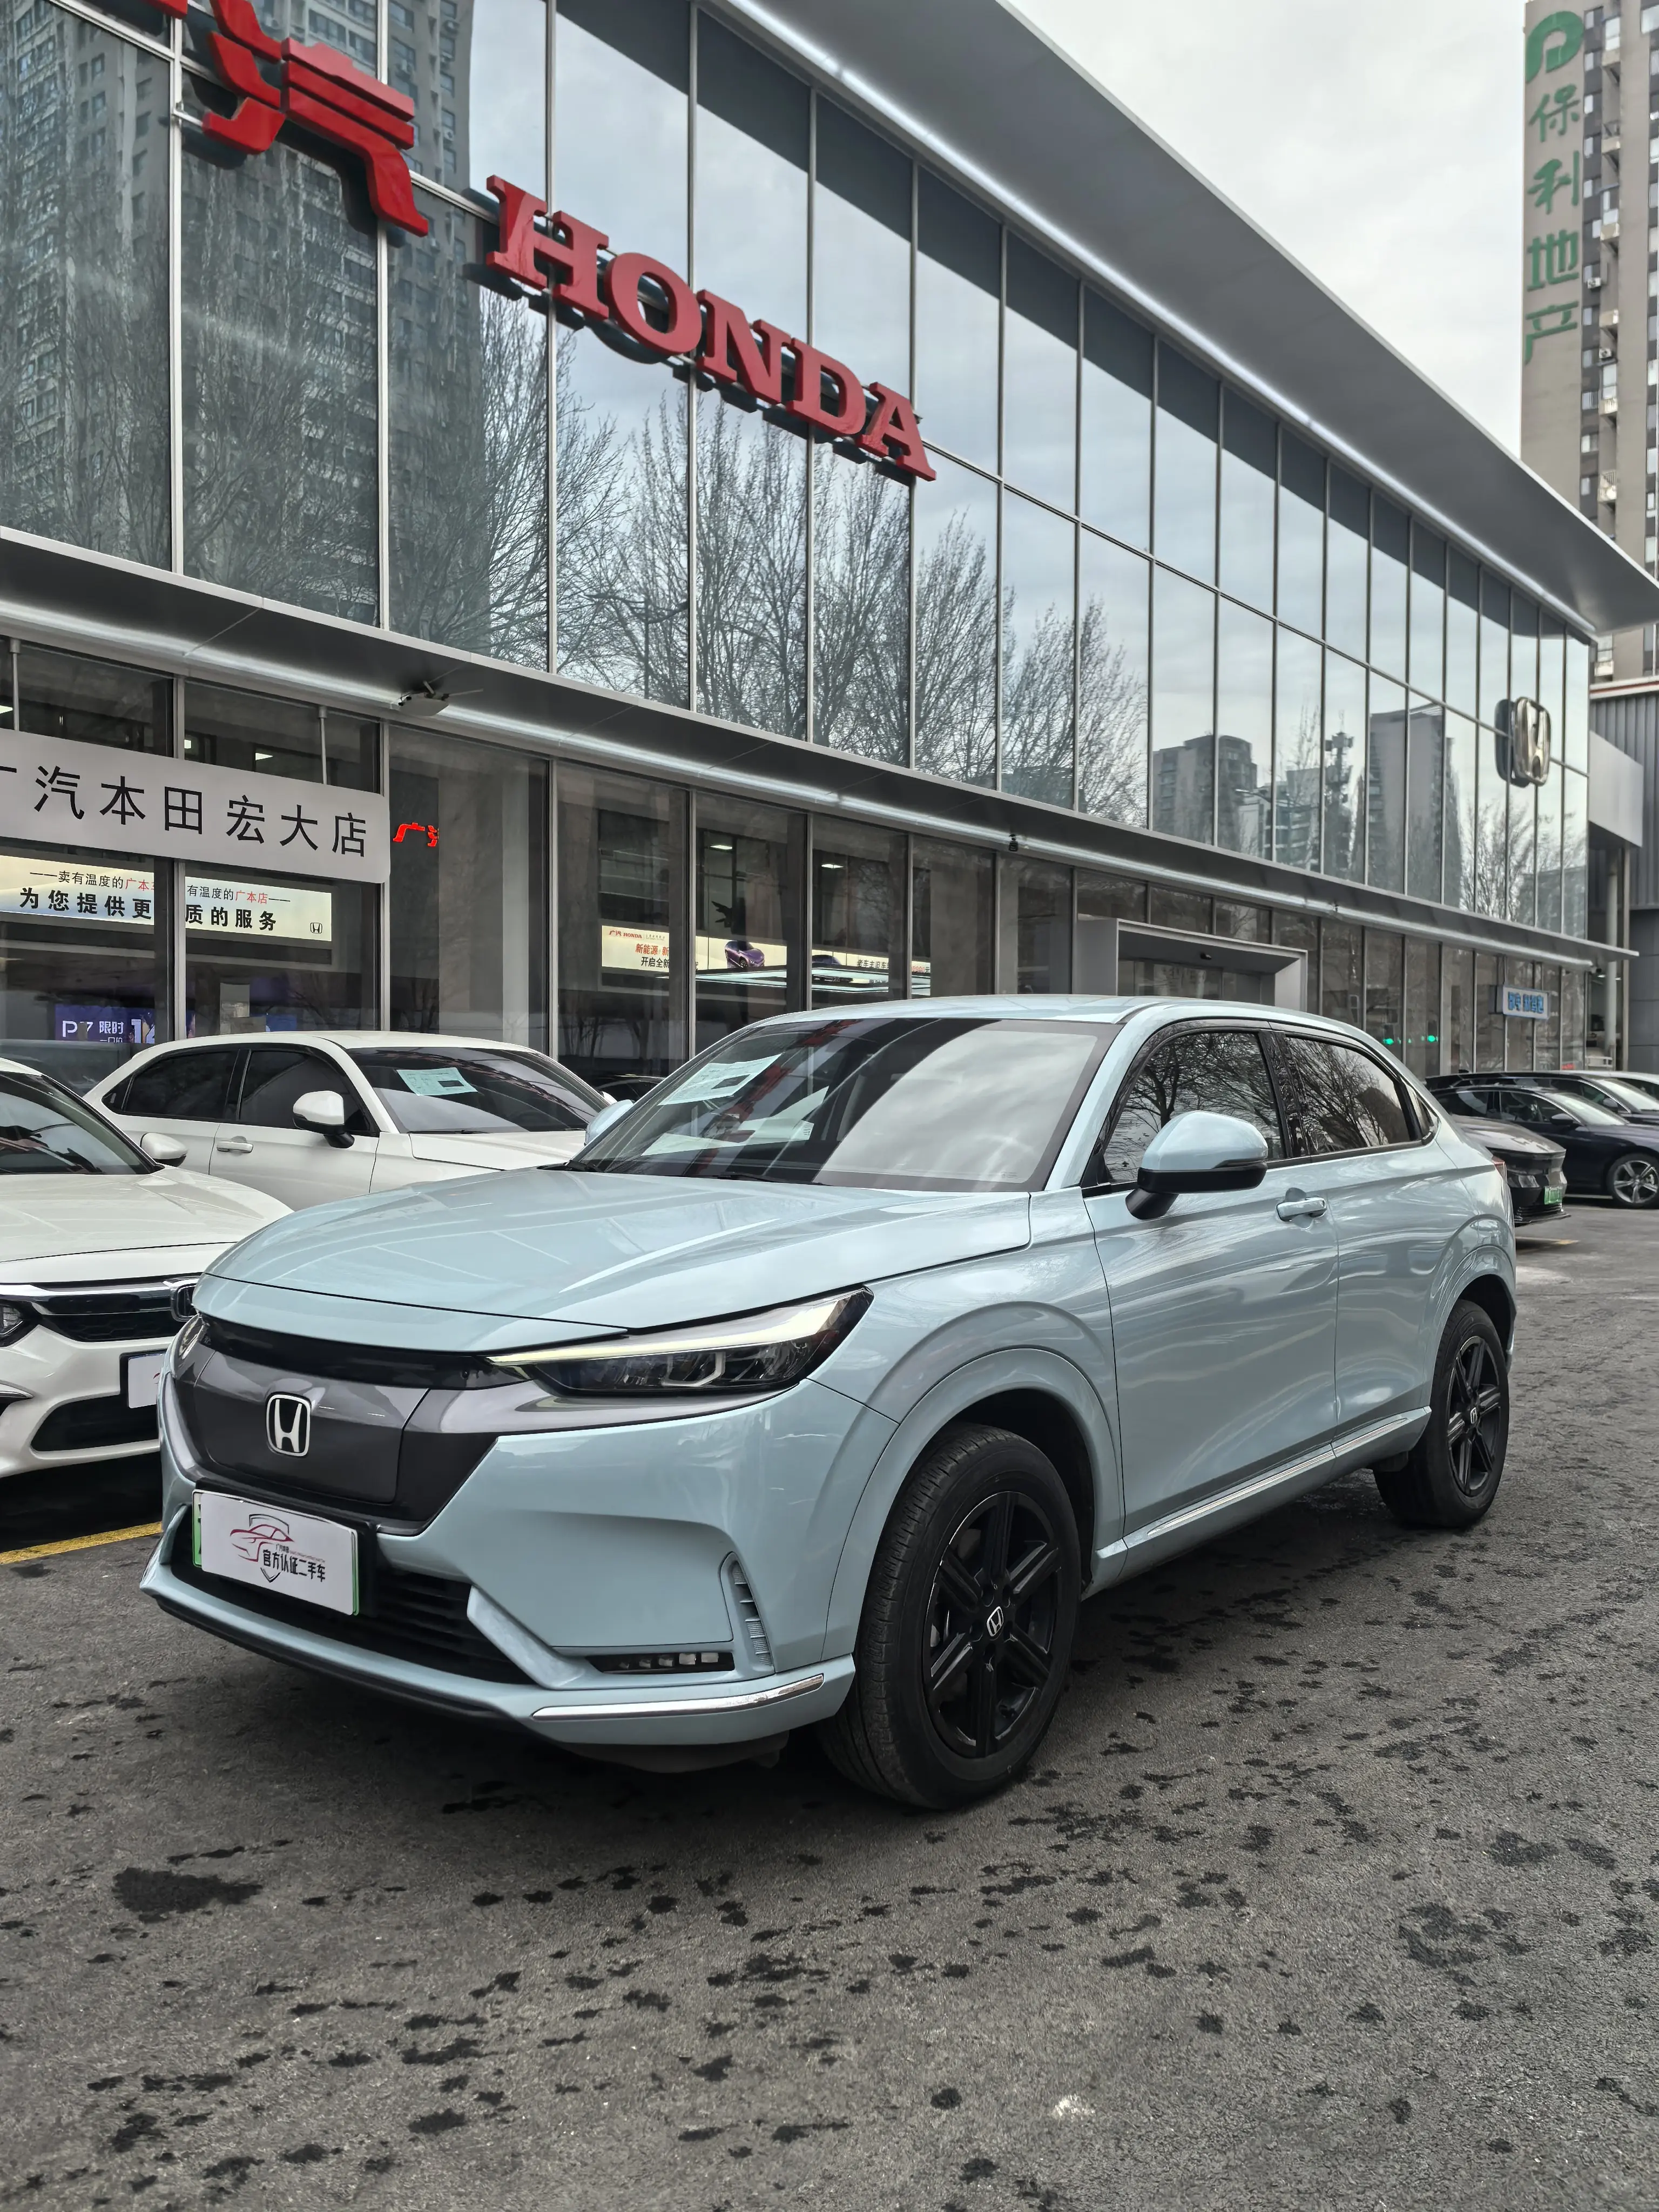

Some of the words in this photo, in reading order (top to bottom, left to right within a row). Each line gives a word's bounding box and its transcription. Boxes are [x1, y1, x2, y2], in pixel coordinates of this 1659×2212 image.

[141, 0, 429, 237] 汽
[1526, 84, 1581, 365] 保利地产
[487, 175, 936, 481] HONDA
[0, 765, 367, 858] 汽本田宏大店
[19, 887, 152, 920] 为您提供更
[186, 904, 276, 931] 质的服务
[857, 959, 889, 970] 老车主旧车
[99, 1021, 124, 1035] 限时
[263, 1549, 326, 1583] 官方认证二手车
